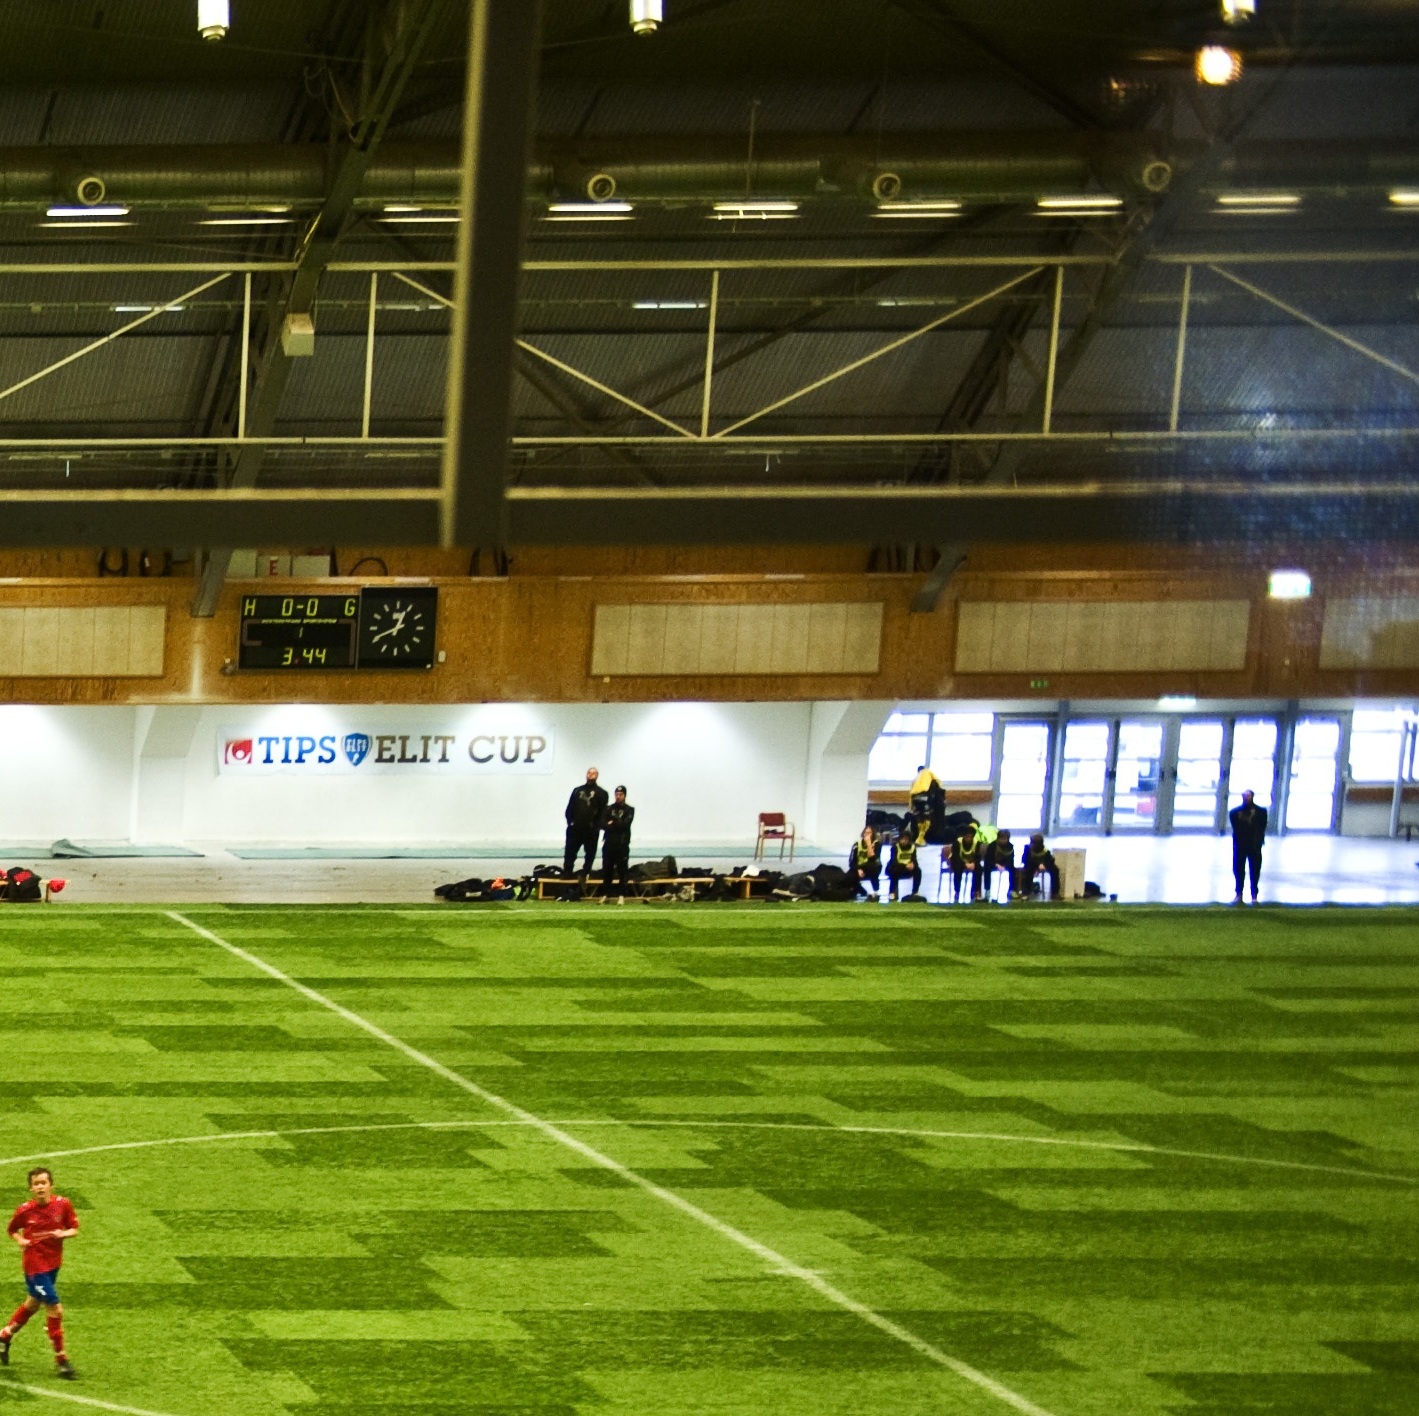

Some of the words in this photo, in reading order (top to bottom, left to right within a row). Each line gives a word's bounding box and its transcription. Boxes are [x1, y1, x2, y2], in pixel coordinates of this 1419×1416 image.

[244, 598, 257, 617] H
[282, 598, 319, 617] 0-0
[344, 598, 356, 617] G
[257, 735, 337, 764] TIPS
[374, 735, 456, 764] ELIT
[468, 734, 547, 765] CUP
